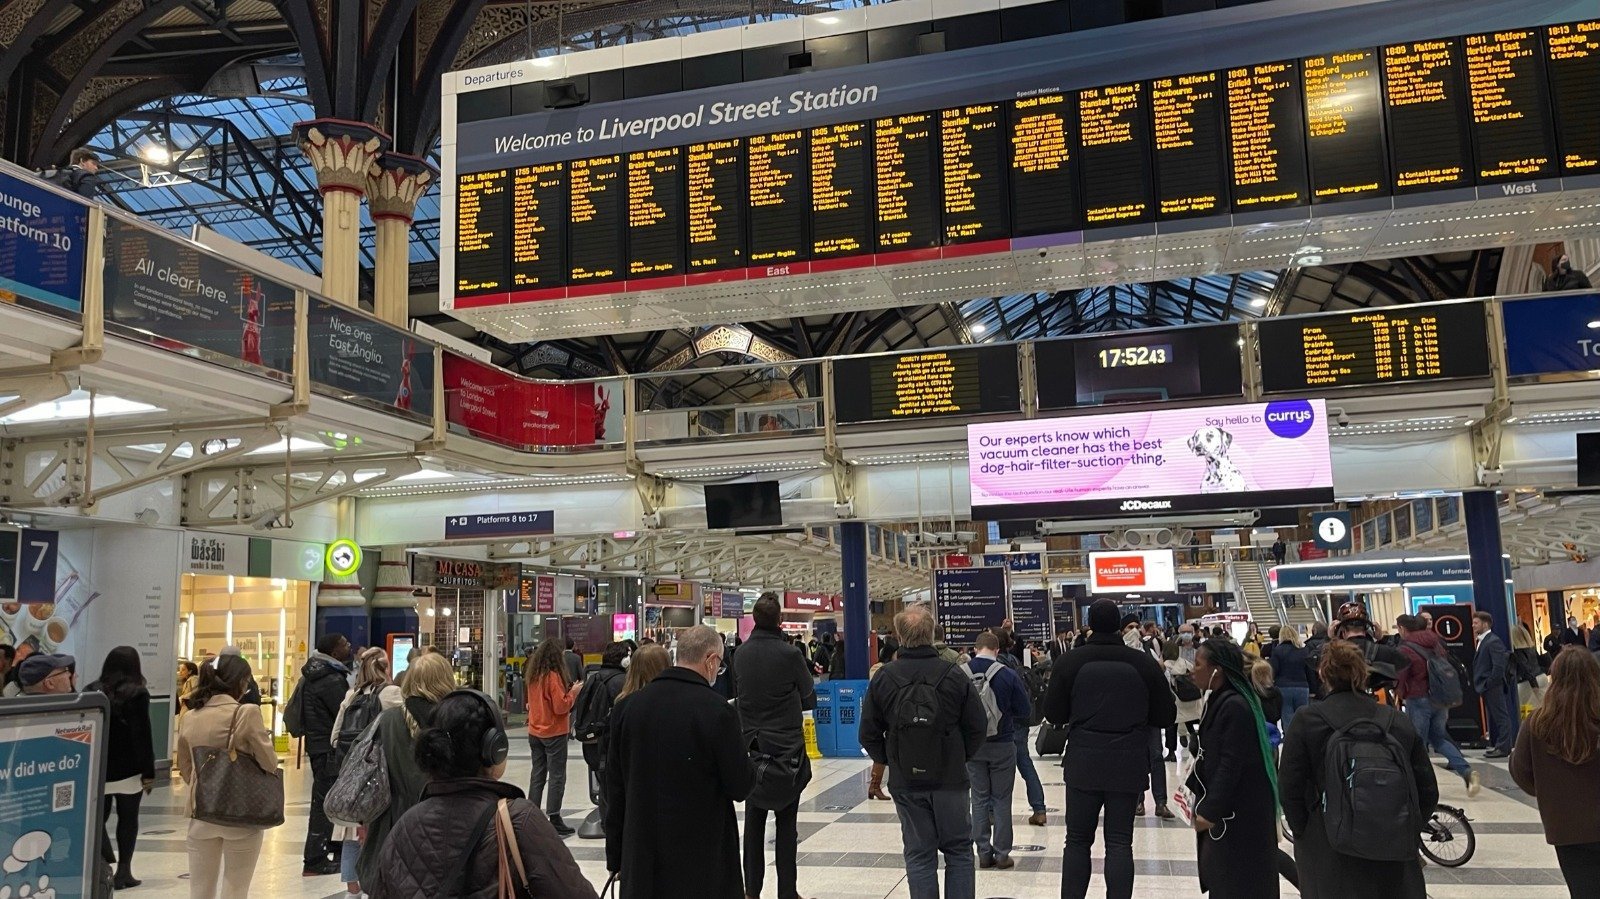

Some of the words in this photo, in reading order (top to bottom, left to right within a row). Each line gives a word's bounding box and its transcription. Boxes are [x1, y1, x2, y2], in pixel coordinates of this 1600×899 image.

[1495, 32, 1526, 42] Platform
[1549, 35, 1587, 46] Cambridge
[1414, 43, 1445, 52] Platform
[1466, 45, 1500, 56] Hertford
[1333, 54, 1363, 63] Platform
[1386, 53, 1420, 66] Stansted
[1422, 51, 1449, 62] Airport
[1255, 65, 1284, 75] Platform
[1305, 66, 1340, 78] Chingford
[464, 70, 524, 86] Departures
[1153, 80, 1172, 89] 17:56
[1179, 76, 1208, 85] Platform
[1228, 78, 1251, 88] Enfield
[1080, 90, 1098, 99] 17:54
[1105, 86, 1133, 96] Platform
[1153, 88, 1192, 98] Broxbourne
[1016, 98, 1037, 109] Special
[1039, 96, 1063, 105] Notices
[1080, 98, 1110, 108] Stansted
[1112, 94, 1136, 104] Airport
[966, 106, 992, 115] Platform
[495, 131, 572, 154] Welcome
[576, 127, 594, 144] to
[598, 104, 704, 139] Liverpool
[708, 96, 782, 124] Street
[788, 85, 878, 114] Station
[899, 115, 924, 124] Platform
[942, 117, 969, 127] Shenfield
[834, 124, 858, 133] Platform
[876, 127, 902, 137] Shenfield
[772, 133, 795, 142] Platform
[689, 152, 712, 161] Shenfield
[629, 161, 655, 169] Braintree
[1481, 168, 1513, 177] Greater
[1516, 165, 1540, 174] Anglia
[571, 169, 590, 177] Ipswich
[515, 175, 537, 184] Shenfield
[1398, 177, 1428, 187] Stansted
[1430, 174, 1458, 183] Express
[1316, 186, 1338, 196] London
[1340, 182, 1378, 194] Overground
[1502, 182, 1538, 196] West
[1260, 193, 1297, 203] Overground
[1088, 212, 1114, 222] Stansted
[1117, 209, 1141, 219] Express
[52, 233, 71, 252] 10
[767, 266, 789, 276] East
[134, 258, 154, 276] All
[158, 267, 194, 290] clear
[196, 279, 228, 304] here.
[330, 316, 352, 335] Nice
[354, 330, 373, 346] one,
[330, 334, 352, 352] East
[352, 344, 383, 364] Anglia.
[460, 377, 482, 392] Welcome
[483, 386, 495, 396] back
[460, 389, 466, 397] to
[466, 391, 484, 404] London
[1206, 417, 1223, 427] Say
[1226, 416, 1249, 424] hello
[1268, 410, 1311, 423] currys
[522, 422, 560, 430] greateranglia
[980, 436, 1001, 446] Our
[1005, 432, 1052, 446] experts
[1056, 431, 1089, 442] know
[1093, 426, 1130, 439] which
[980, 449, 1028, 460] vacuum
[1031, 445, 1079, 457] cleaner
[1083, 443, 1105, 453] has
[1109, 441, 1130, 452] the
[1134, 437, 1163, 450] best
[980, 453, 1166, 475] dog-hair-filter-suction-thing.
[1120, 500, 1172, 510] JCDecaux
[477, 516, 510, 524] Platforms
[30, 541, 49, 572] 7
[192, 543, 224, 561] wasabi
[439, 560, 452, 575] MI
[455, 562, 481, 577] CASA
[591, 584, 596, 600] 9
[15, 761, 34, 777] did
[38, 762, 55, 773] we
[59, 754, 81, 770] do?
